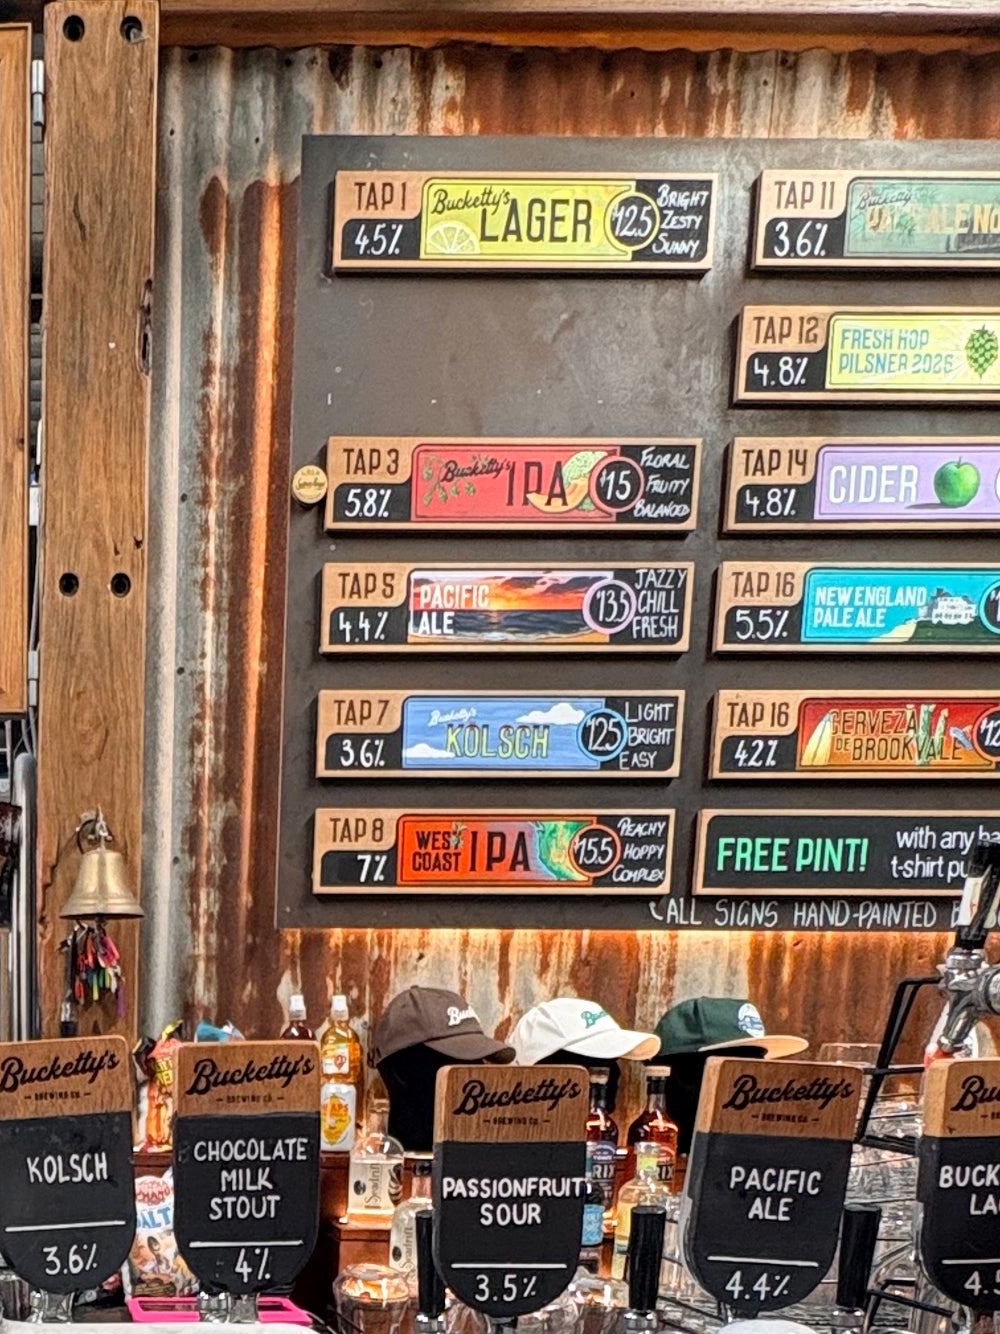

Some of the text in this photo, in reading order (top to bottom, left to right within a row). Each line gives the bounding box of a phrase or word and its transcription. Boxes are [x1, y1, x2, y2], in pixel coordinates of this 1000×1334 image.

[354, 182, 407, 211] TAP 1
[431, 186, 510, 215] Bucketty's
[775, 181, 814, 209] TAP
[820, 181, 835, 210] 11
[479, 198, 592, 243] LAGER
[354, 222, 401, 256] 4.5%
[774, 221, 828, 257] 3.6%
[753, 317, 819, 344] TAP 12
[841, 329, 928, 349] FRESH HOP
[754, 356, 808, 386] 4.8%
[839, 353, 954, 373] PILSNER 2026
[343, 449, 399, 475] TAP 3
[640, 446, 690, 469] FLORAL
[742, 449, 807, 476] TAP 14
[505, 461, 568, 507] IPA
[600, 469, 631, 500] $15
[829, 465, 918, 503] CIDER
[344, 488, 391, 517] 5.8%
[745, 488, 796, 516] 4.8%
[338, 573, 394, 599] TAP 5
[635, 568, 688, 590] JAZZY
[732, 572, 794, 597] TAP 16
[420, 584, 489, 608] PACIFIC
[638, 590, 679, 614] CHILL
[815, 586, 927, 607] NEW ENGLAND
[339, 611, 386, 642] 4.4%
[418, 612, 454, 635] ALE
[633, 616, 677, 639] FRESH
[736, 609, 789, 640] 5.5%
[813, 609, 887, 628] PALE ALE
[334, 700, 390, 725] TAP 7
[625, 702, 674, 722] LIGHT
[728, 702, 790, 727] TAP 16
[831, 709, 916, 735] CERVEZA
[628, 728, 675, 745] BRIGHT
[836, 736, 962, 761] DE BROOKVALE
[341, 739, 386, 767] 3.6%
[619, 751, 657, 770] EASY
[735, 740, 776, 767] 4.2%
[329, 818, 384, 843] TAP 8
[618, 818, 665, 837] PEACHY
[896, 826, 937, 848] with
[940, 830, 974, 854] any
[412, 853, 462, 872] COAST
[416, 830, 531, 872] WEST IPA
[624, 843, 665, 860] HOPPY
[717, 838, 868, 872] FREE PINT!
[358, 854, 387, 881] 7%
[613, 865, 665, 883] COMPLEX
[891, 855, 943, 878] t-shirt
[667, 900, 701, 924] ALL
[716, 900, 778, 926] SIGNS
[794, 901, 936, 927] HAND-PAINTED
[186, 1055, 315, 1095] Bucketty's
[454, 1077, 581, 1115] Bucketty's
[722, 1074, 854, 1110] Bucketty's
[194, 1138, 308, 1161] CHOCOLATE
[27, 1152, 109, 1183] KOLSCH
[220, 1167, 273, 1192] MILK
[729, 1166, 821, 1195] PACIFIC
[443, 1177, 588, 1199] PASSIONFRUIT
[209, 1196, 280, 1220] STOUT
[480, 1203, 542, 1226] SOUR
[748, 1198, 793, 1221] ALE
[43, 1243, 97, 1275] 3.6%
[235, 1248, 270, 1283] 4%
[475, 1274, 536, 1301] 3.5%
[725, 1270, 791, 1300] 4.4%
